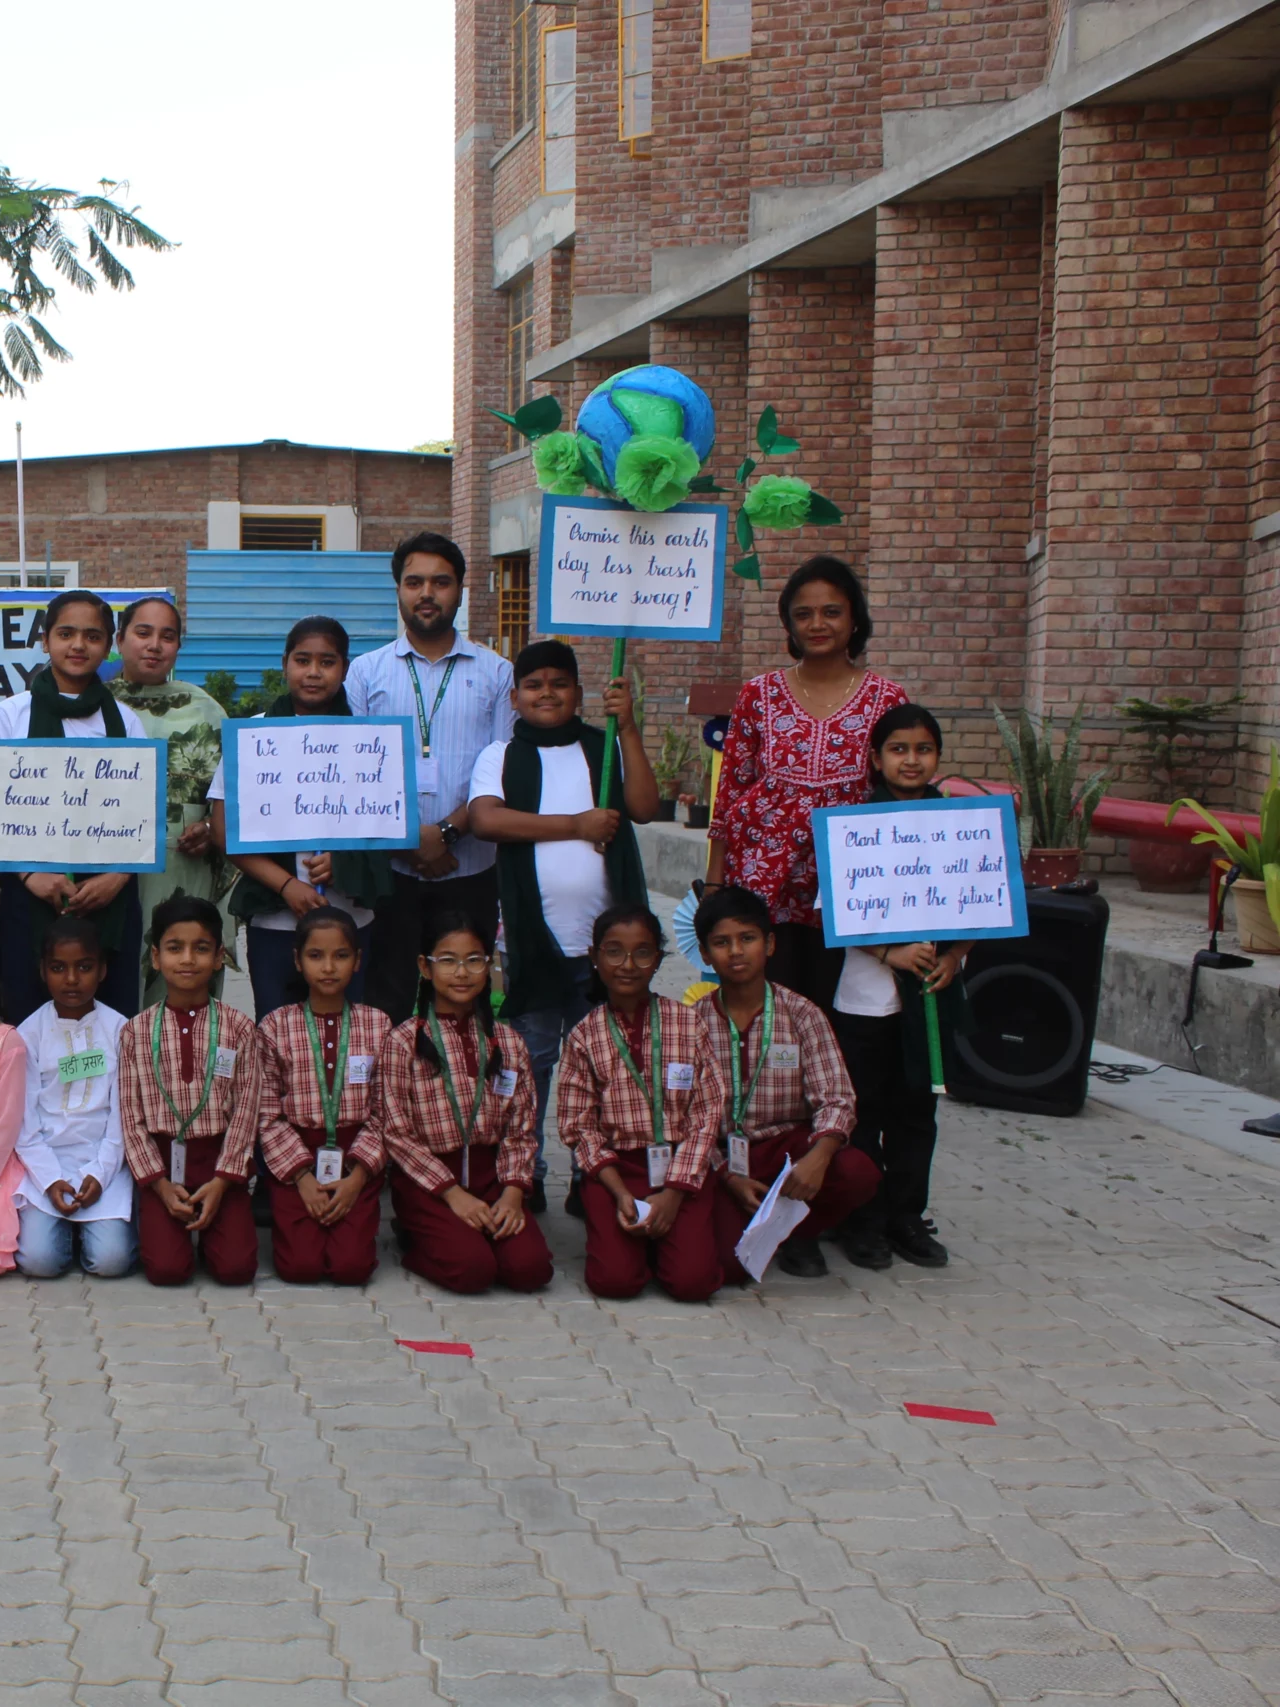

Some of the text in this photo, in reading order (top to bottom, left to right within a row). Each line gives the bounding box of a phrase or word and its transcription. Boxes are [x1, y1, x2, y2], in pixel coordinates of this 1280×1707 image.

[629, 524, 655, 546] this
[664, 527, 709, 548] earth
[558, 551, 696, 584] day less trash
[569, 589, 618, 603] more
[302, 734, 339, 755] have
[352, 736, 389, 766] only
[64, 756, 84, 779] the
[256, 772, 283, 785] one
[355, 767, 383, 783] not
[5, 785, 120, 807] because rent on
[260, 803, 272, 816] a
[294, 794, 349, 823] backup
[1, 823, 37, 837] mars
[45, 822, 56, 836] is
[61, 818, 82, 837] too
[931, 831, 946, 843] or
[956, 828, 990, 841] even
[845, 855, 1003, 890] your cooler will start
[846, 891, 890, 920] crying
[902, 891, 917, 907] in
[925, 886, 947, 906] the
